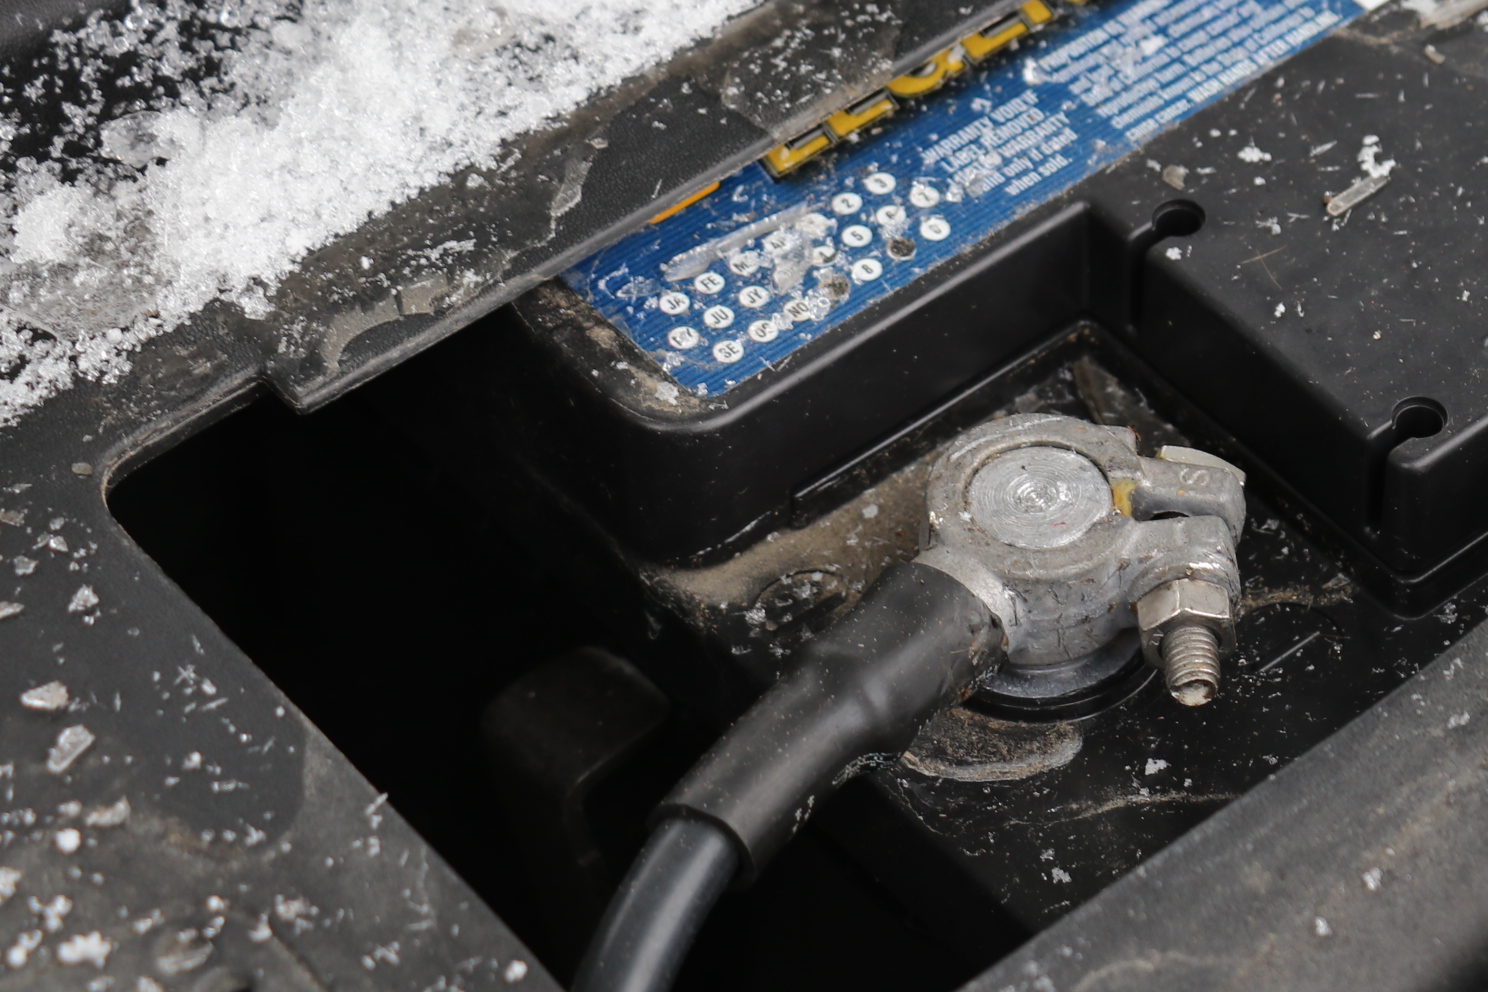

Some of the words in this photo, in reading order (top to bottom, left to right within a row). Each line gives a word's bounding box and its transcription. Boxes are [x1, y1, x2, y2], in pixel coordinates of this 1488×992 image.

[921, 116, 994, 163] WARRANTY
[941, 142, 985, 172] LABEL
[998, 112, 1069, 158] WARRANTY
[1001, 155, 1034, 179] only
[1028, 148, 1042, 161] if
[1039, 127, 1077, 154] dated
[1003, 169, 1041, 195] when
[1037, 151, 1072, 176] sold.
[700, 275, 720, 291] FE
[841, 196, 855, 209] 2
[873, 177, 887, 189] 3
[711, 308, 729, 325] JU
[745, 288, 762, 304] JY
[850, 230, 864, 242] 5
[718, 341, 740, 359] SE
[860, 263, 874, 275] 8
